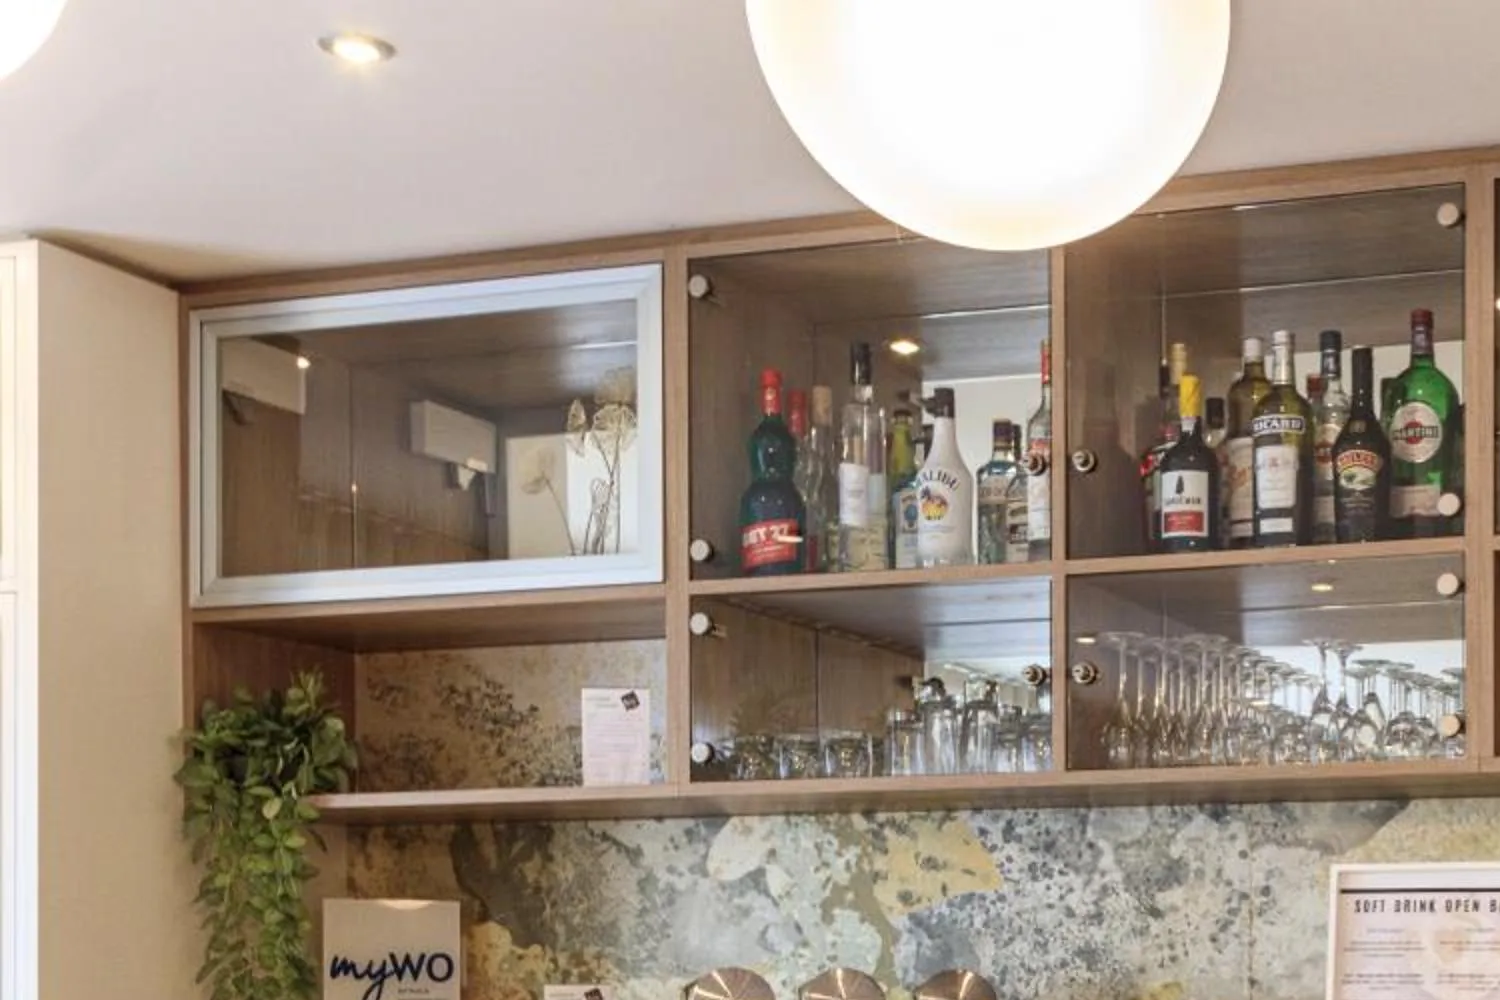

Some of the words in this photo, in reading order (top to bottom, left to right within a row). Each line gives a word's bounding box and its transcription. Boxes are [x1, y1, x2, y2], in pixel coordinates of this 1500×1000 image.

[1354, 899, 1385, 914] SOFT
[1394, 899, 1436, 914] DRINK
[1445, 898, 1481, 913] OPEN
